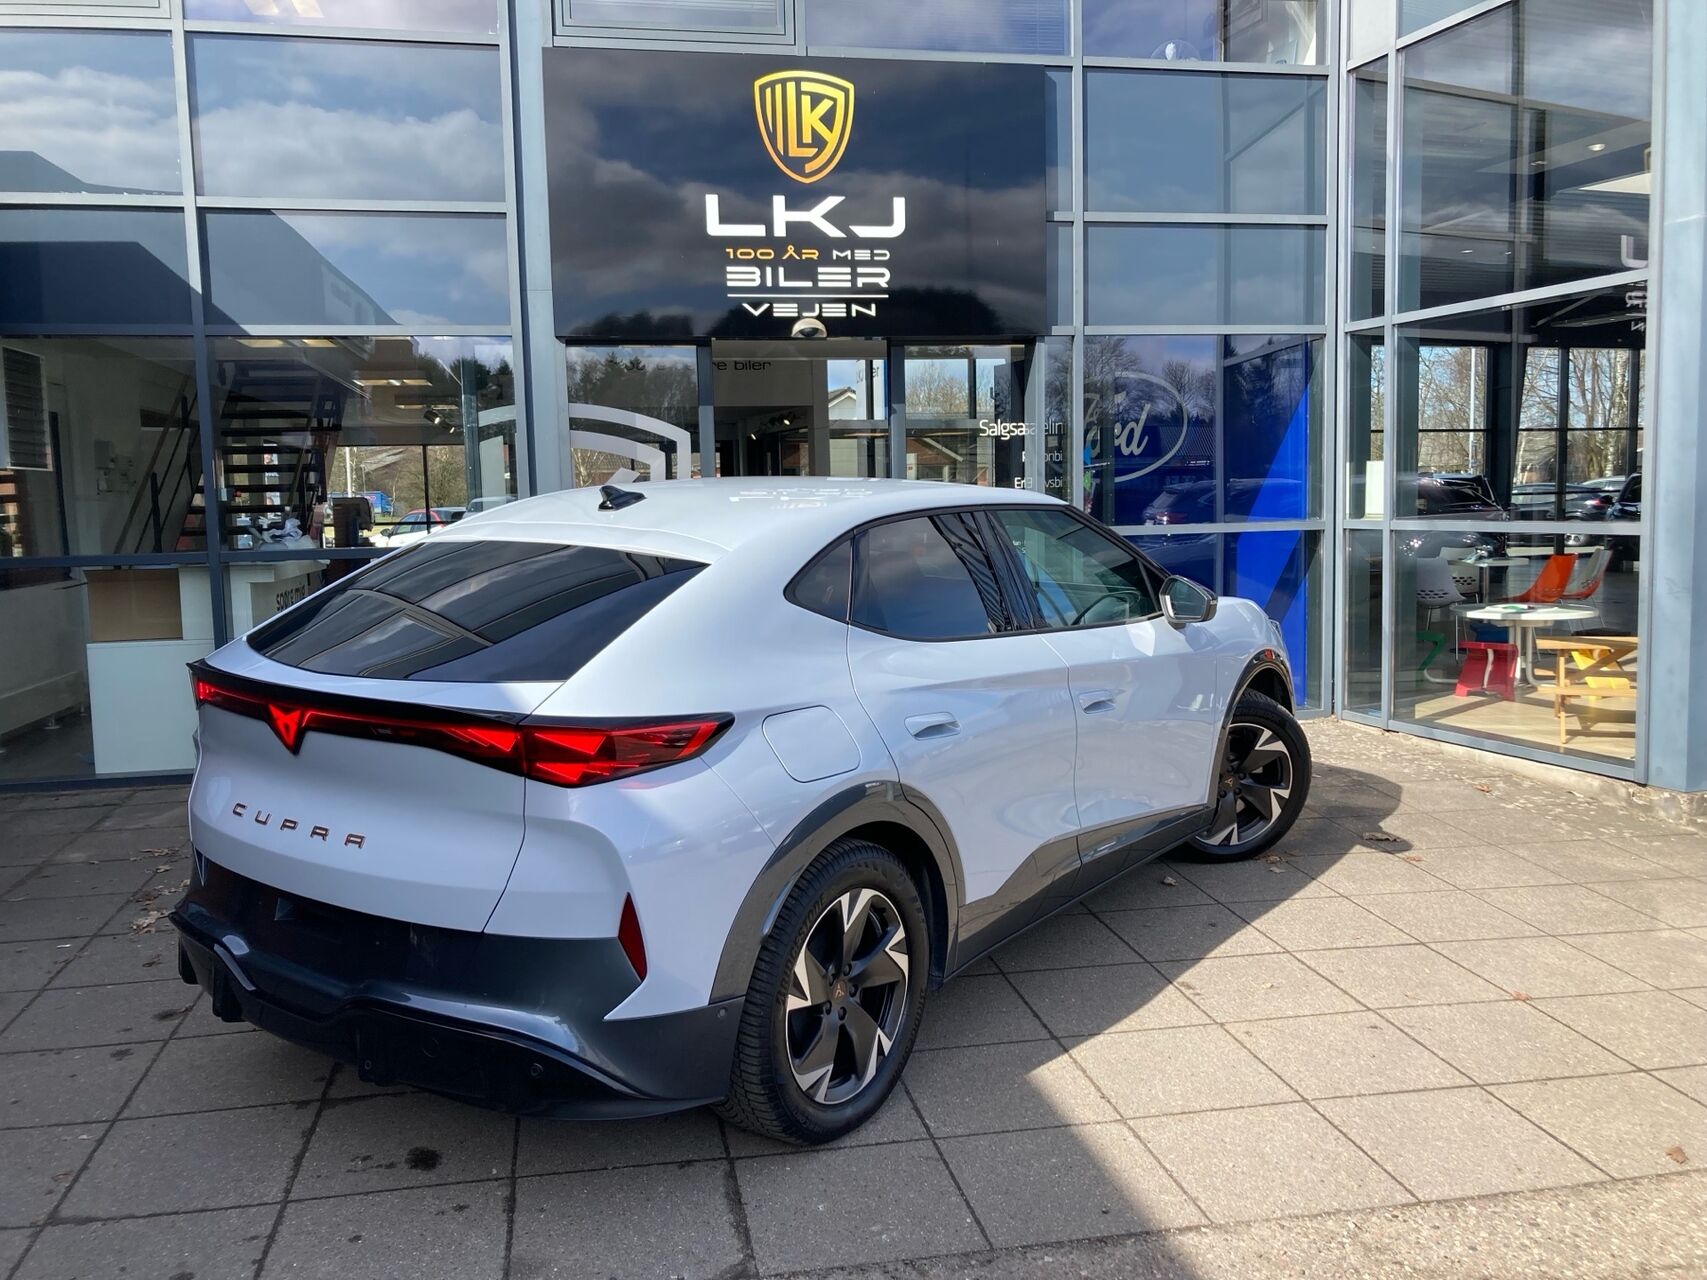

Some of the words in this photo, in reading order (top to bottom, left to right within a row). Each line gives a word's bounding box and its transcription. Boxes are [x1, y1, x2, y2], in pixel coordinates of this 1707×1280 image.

[705, 194, 906, 238] LKJ
[726, 248, 775, 260] 100
[782, 244, 819, 260] ÅR
[832, 249, 891, 261] MED
[726, 266, 891, 288] BILER
[742, 303, 876, 317] VEJEN
[734, 360, 772, 371] biler
[232, 802, 366, 849] CUPRA
